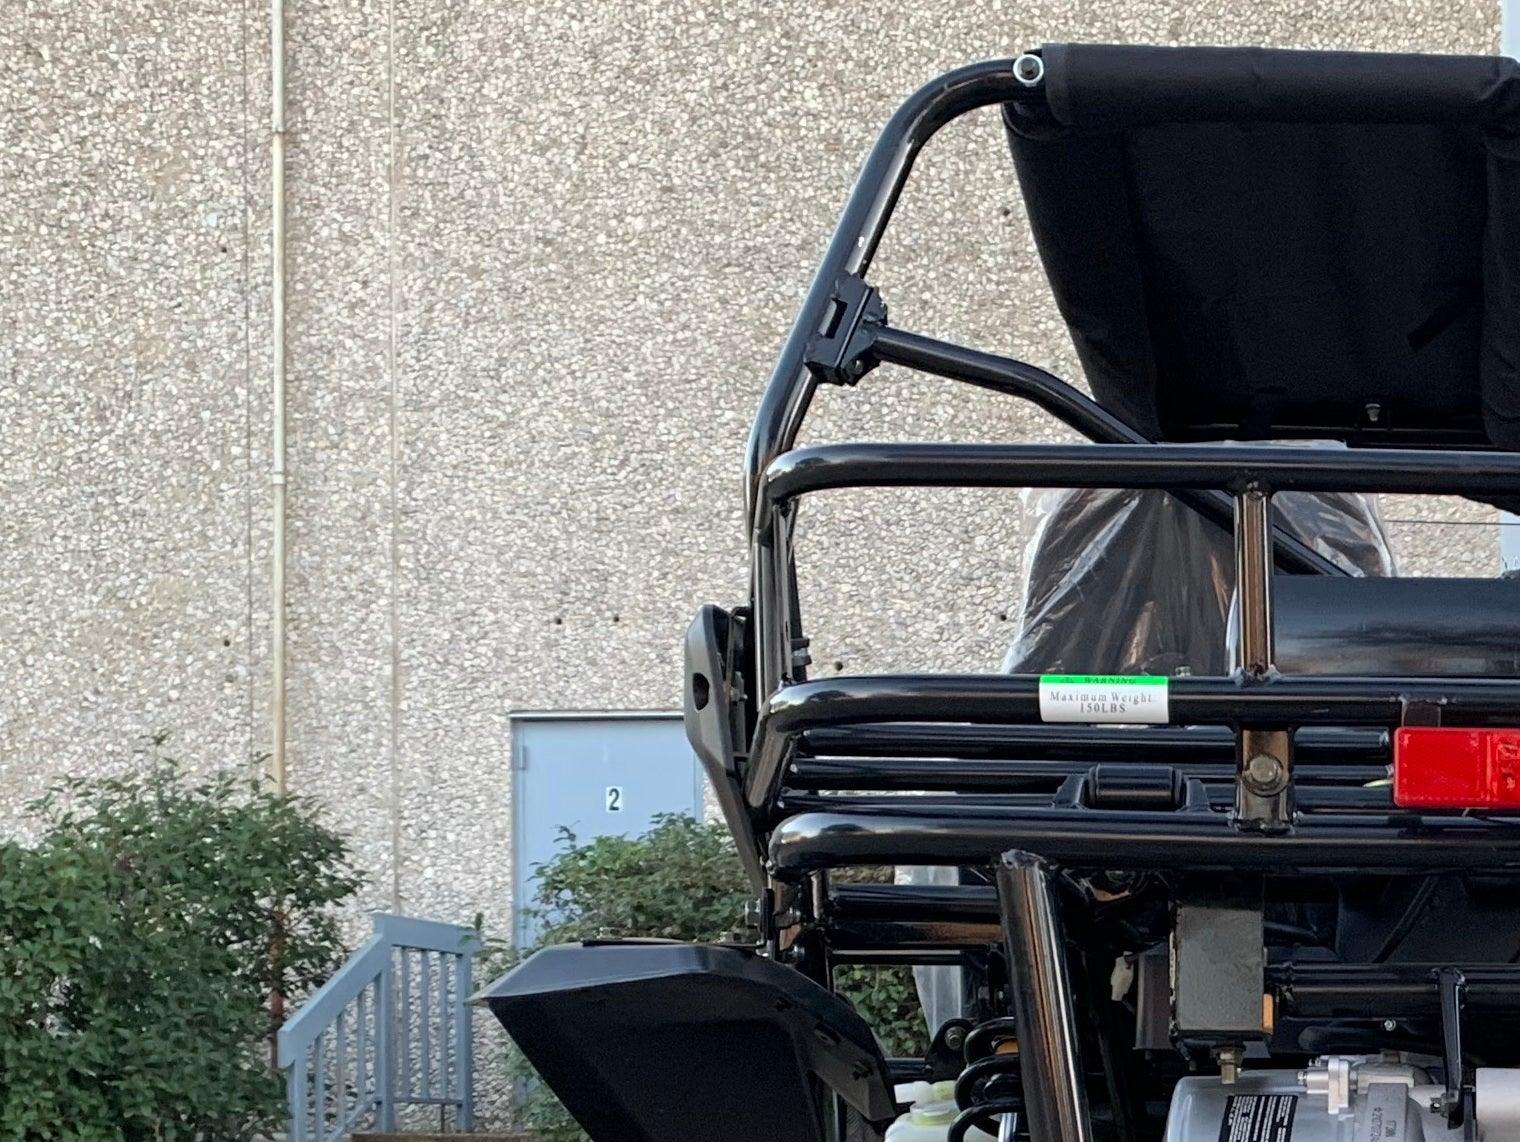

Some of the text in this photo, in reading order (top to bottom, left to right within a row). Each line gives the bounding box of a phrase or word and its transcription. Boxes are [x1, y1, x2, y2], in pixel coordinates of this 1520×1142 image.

[1049, 691, 1152, 705] Maximum Weight
[1080, 702, 1127, 714] 150LBS
[608, 788, 620, 811] 2
